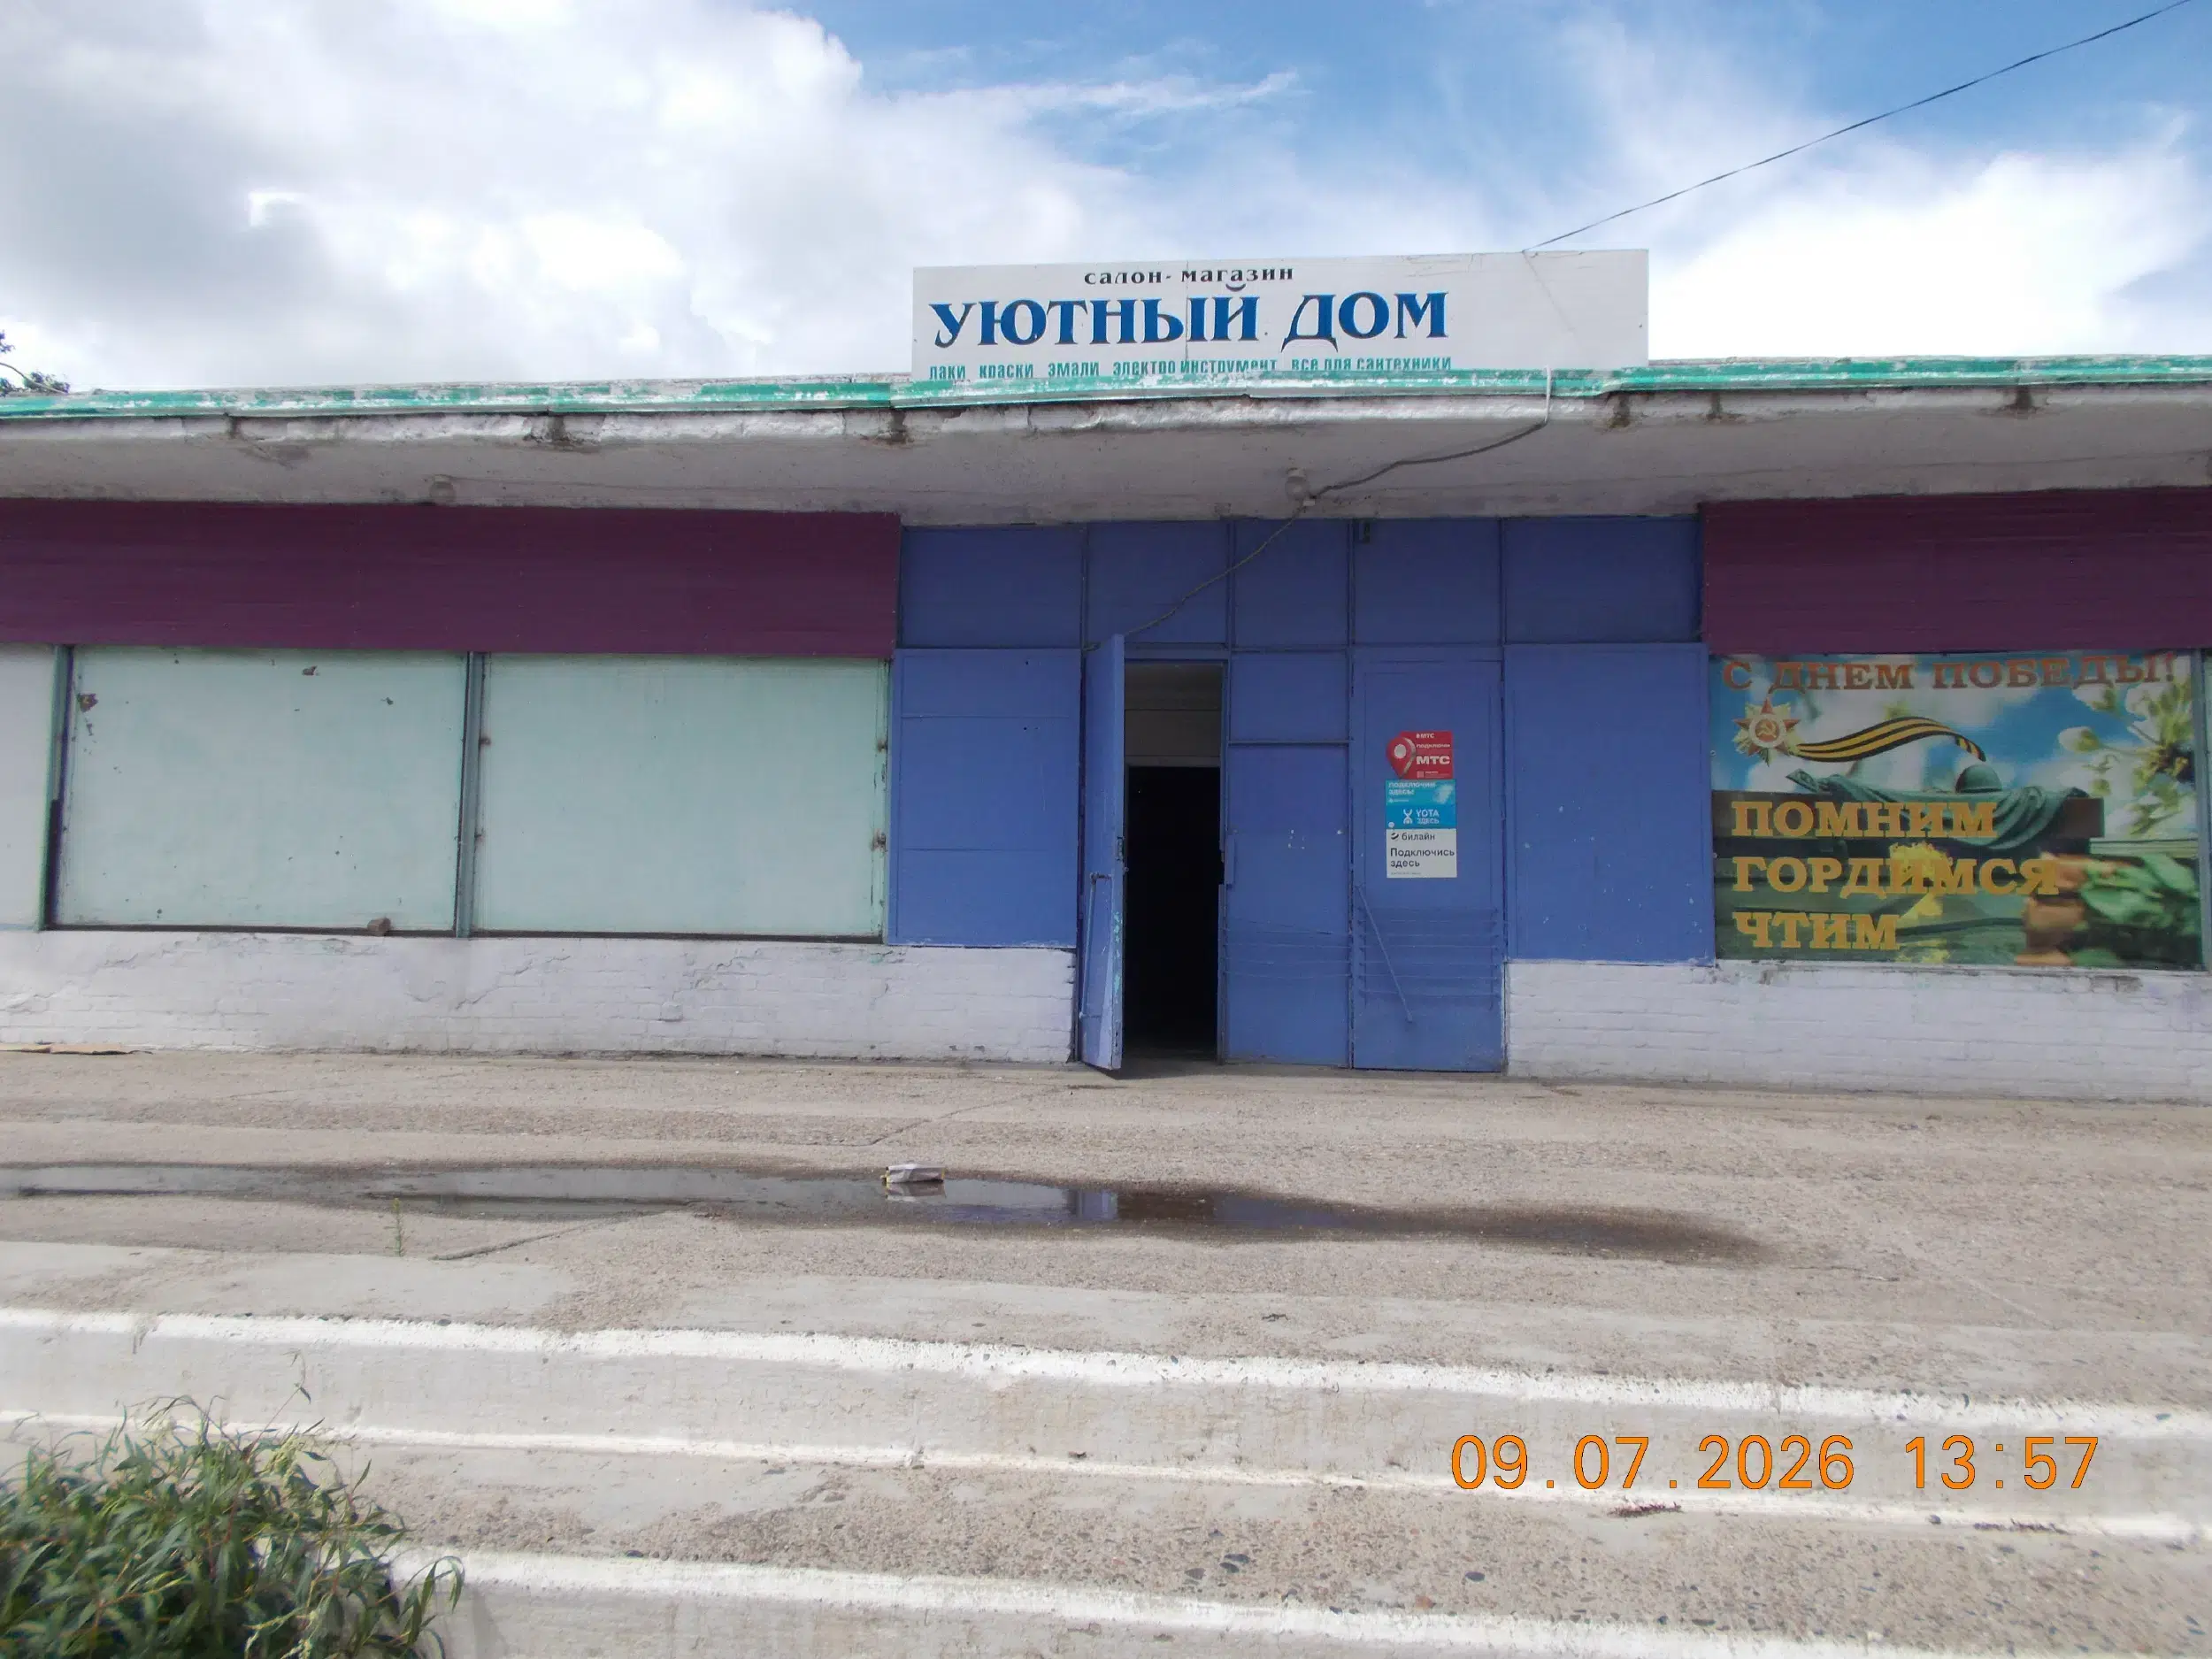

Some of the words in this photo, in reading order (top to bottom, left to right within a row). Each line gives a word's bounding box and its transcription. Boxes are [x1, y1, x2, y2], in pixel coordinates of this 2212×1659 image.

[1181, 268, 1294, 282] магазин
[929, 283, 1260, 349] УЮТНЫЙ
[1280, 291, 1449, 353] ДОМ
[1723, 661, 1753, 689] С
[1769, 661, 1914, 694] ДНЕМ
[1932, 653, 2174, 690] ПОБЕДЫ!
[1417, 756, 1450, 764] МТС
[1416, 809, 1440, 818] YOTA
[1732, 801, 1998, 838] ПОМНИМ
[1402, 832, 1435, 841] билайн
[1390, 848, 1455, 857] Подключись
[1732, 856, 2061, 901] ГОРДИМСЯ
[1732, 912, 1901, 951] ЧТИМ
